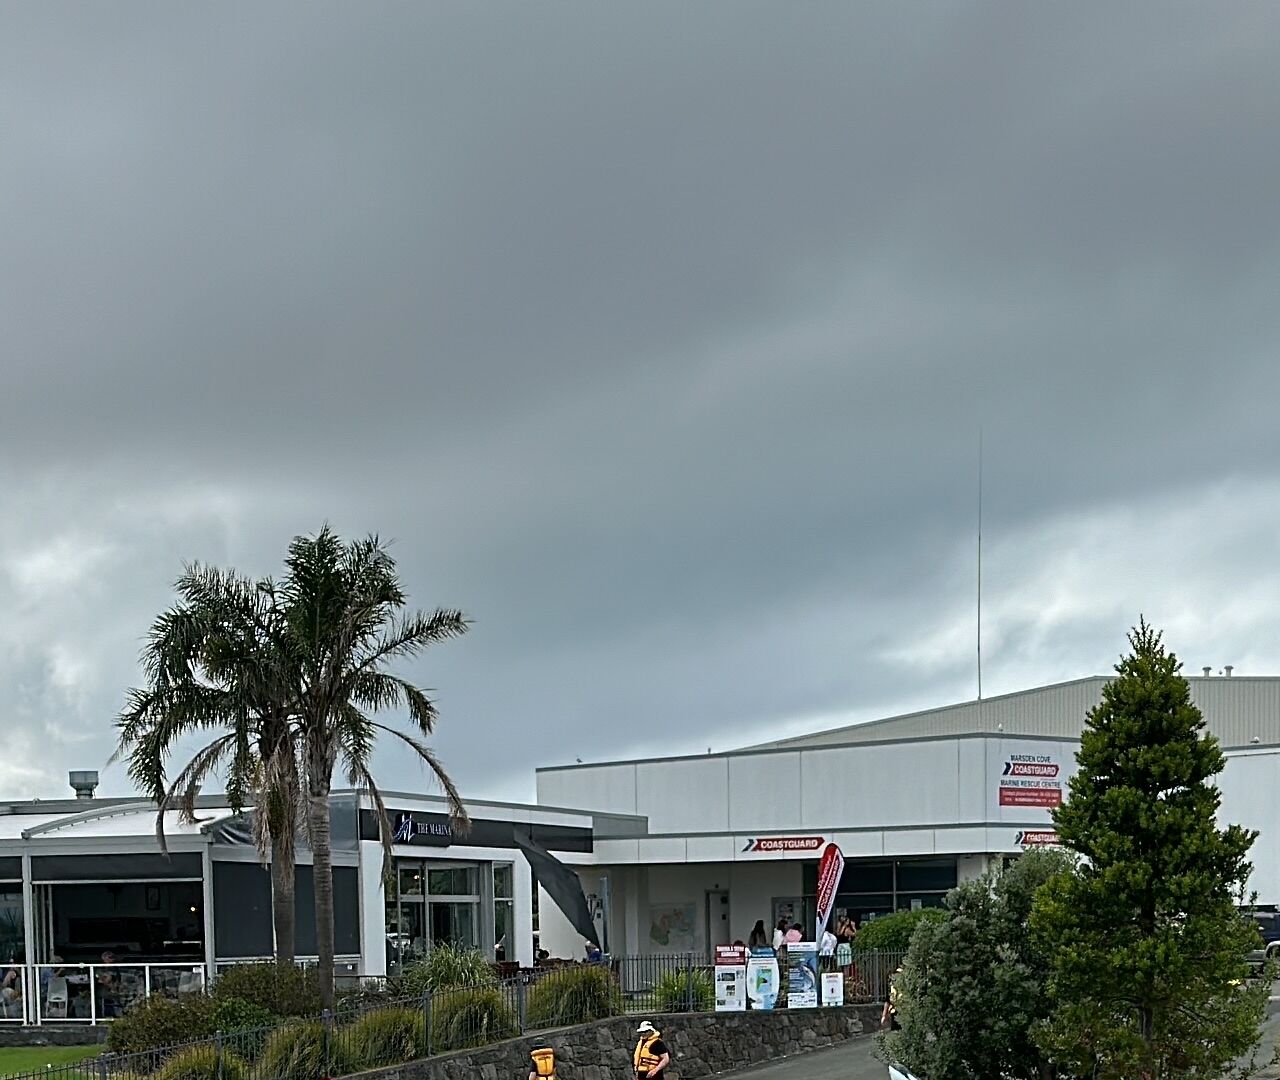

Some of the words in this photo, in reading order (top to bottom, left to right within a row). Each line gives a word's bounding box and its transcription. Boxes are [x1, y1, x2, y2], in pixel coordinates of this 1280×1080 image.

[1010, 754, 1035, 763] MARSDEN
[1014, 764, 1056, 775] COASTGUARD
[417, 822, 428, 834] THE
[760, 839, 818, 849] COASTGUARD
